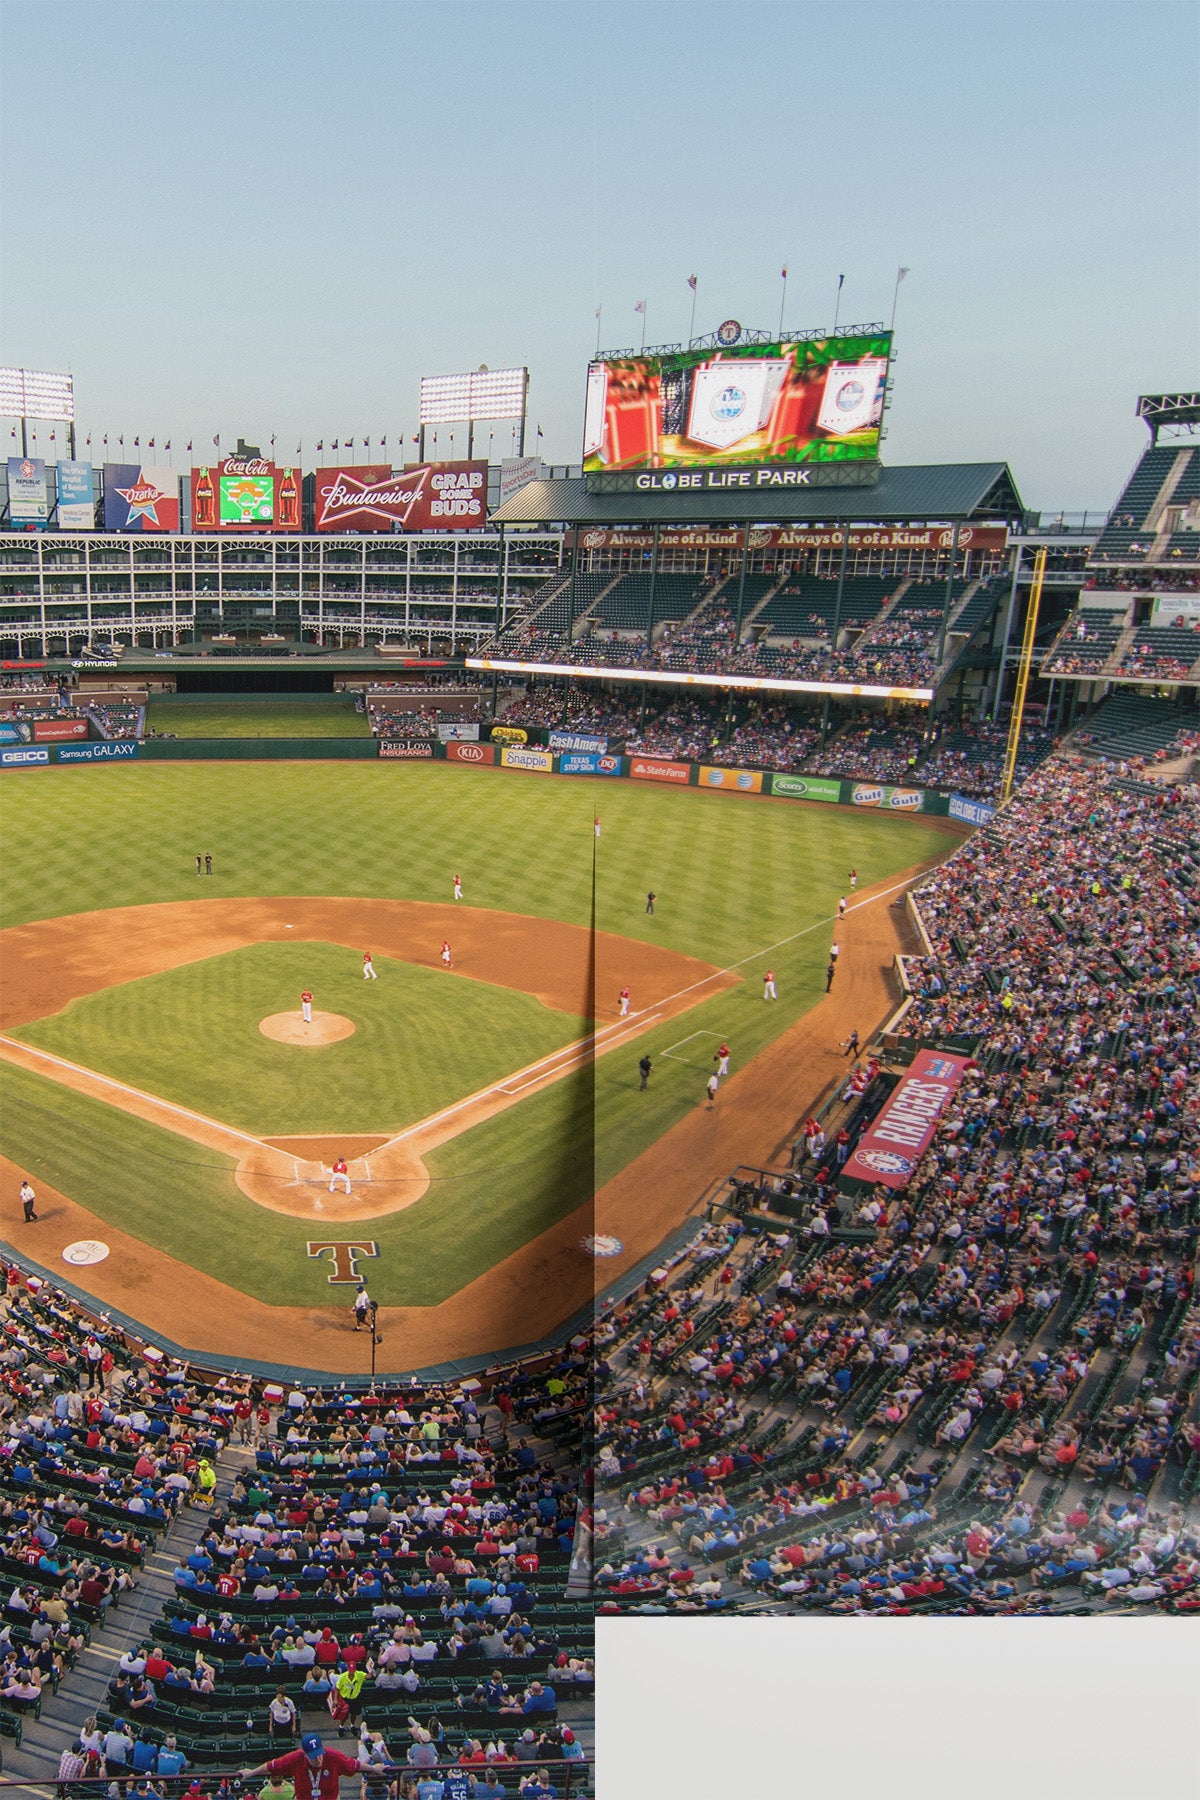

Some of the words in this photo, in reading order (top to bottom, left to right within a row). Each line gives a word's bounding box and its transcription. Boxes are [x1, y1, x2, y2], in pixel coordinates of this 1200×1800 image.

[223, 458, 270, 475] Coca-Cola
[431, 472, 483, 490] GRAB
[636, 474, 702, 490] GLOBE
[708, 472, 750, 487] LIFE
[756, 470, 810, 485] PARK
[126, 488, 158, 503] Ozarka
[321, 485, 424, 508] Budweiser
[439, 489, 473, 500] SOME
[430, 499, 481, 517] BUDS
[609, 533, 654, 546] Always
[686, 532, 700, 544] of
[705, 533, 737, 544] Kind
[778, 532, 829, 545] Always
[863, 531, 880, 544] of
[880, 534, 889, 544] a
[892, 531, 930, 544] Kind
[381, 741, 405, 750] FRED
[408, 741, 431, 750] LOYA
[549, 734, 574, 748] Cash
[2, 751, 48, 762] GEICO
[60, 750, 92, 759] Samsung
[93, 745, 135, 756] GALAXY
[461, 748, 479, 758] KIA
[507, 751, 547, 768] Snapple
[600, 760, 615, 769] DQ
[854, 791, 882, 801] Gulf
[891, 795, 920, 806] Gulf
[956, 800, 977, 821] GLOBE
[873, 1078, 949, 1147] RANGERS
[306, 1241, 381, 1286] T
[309, 1739, 317, 1748] T
